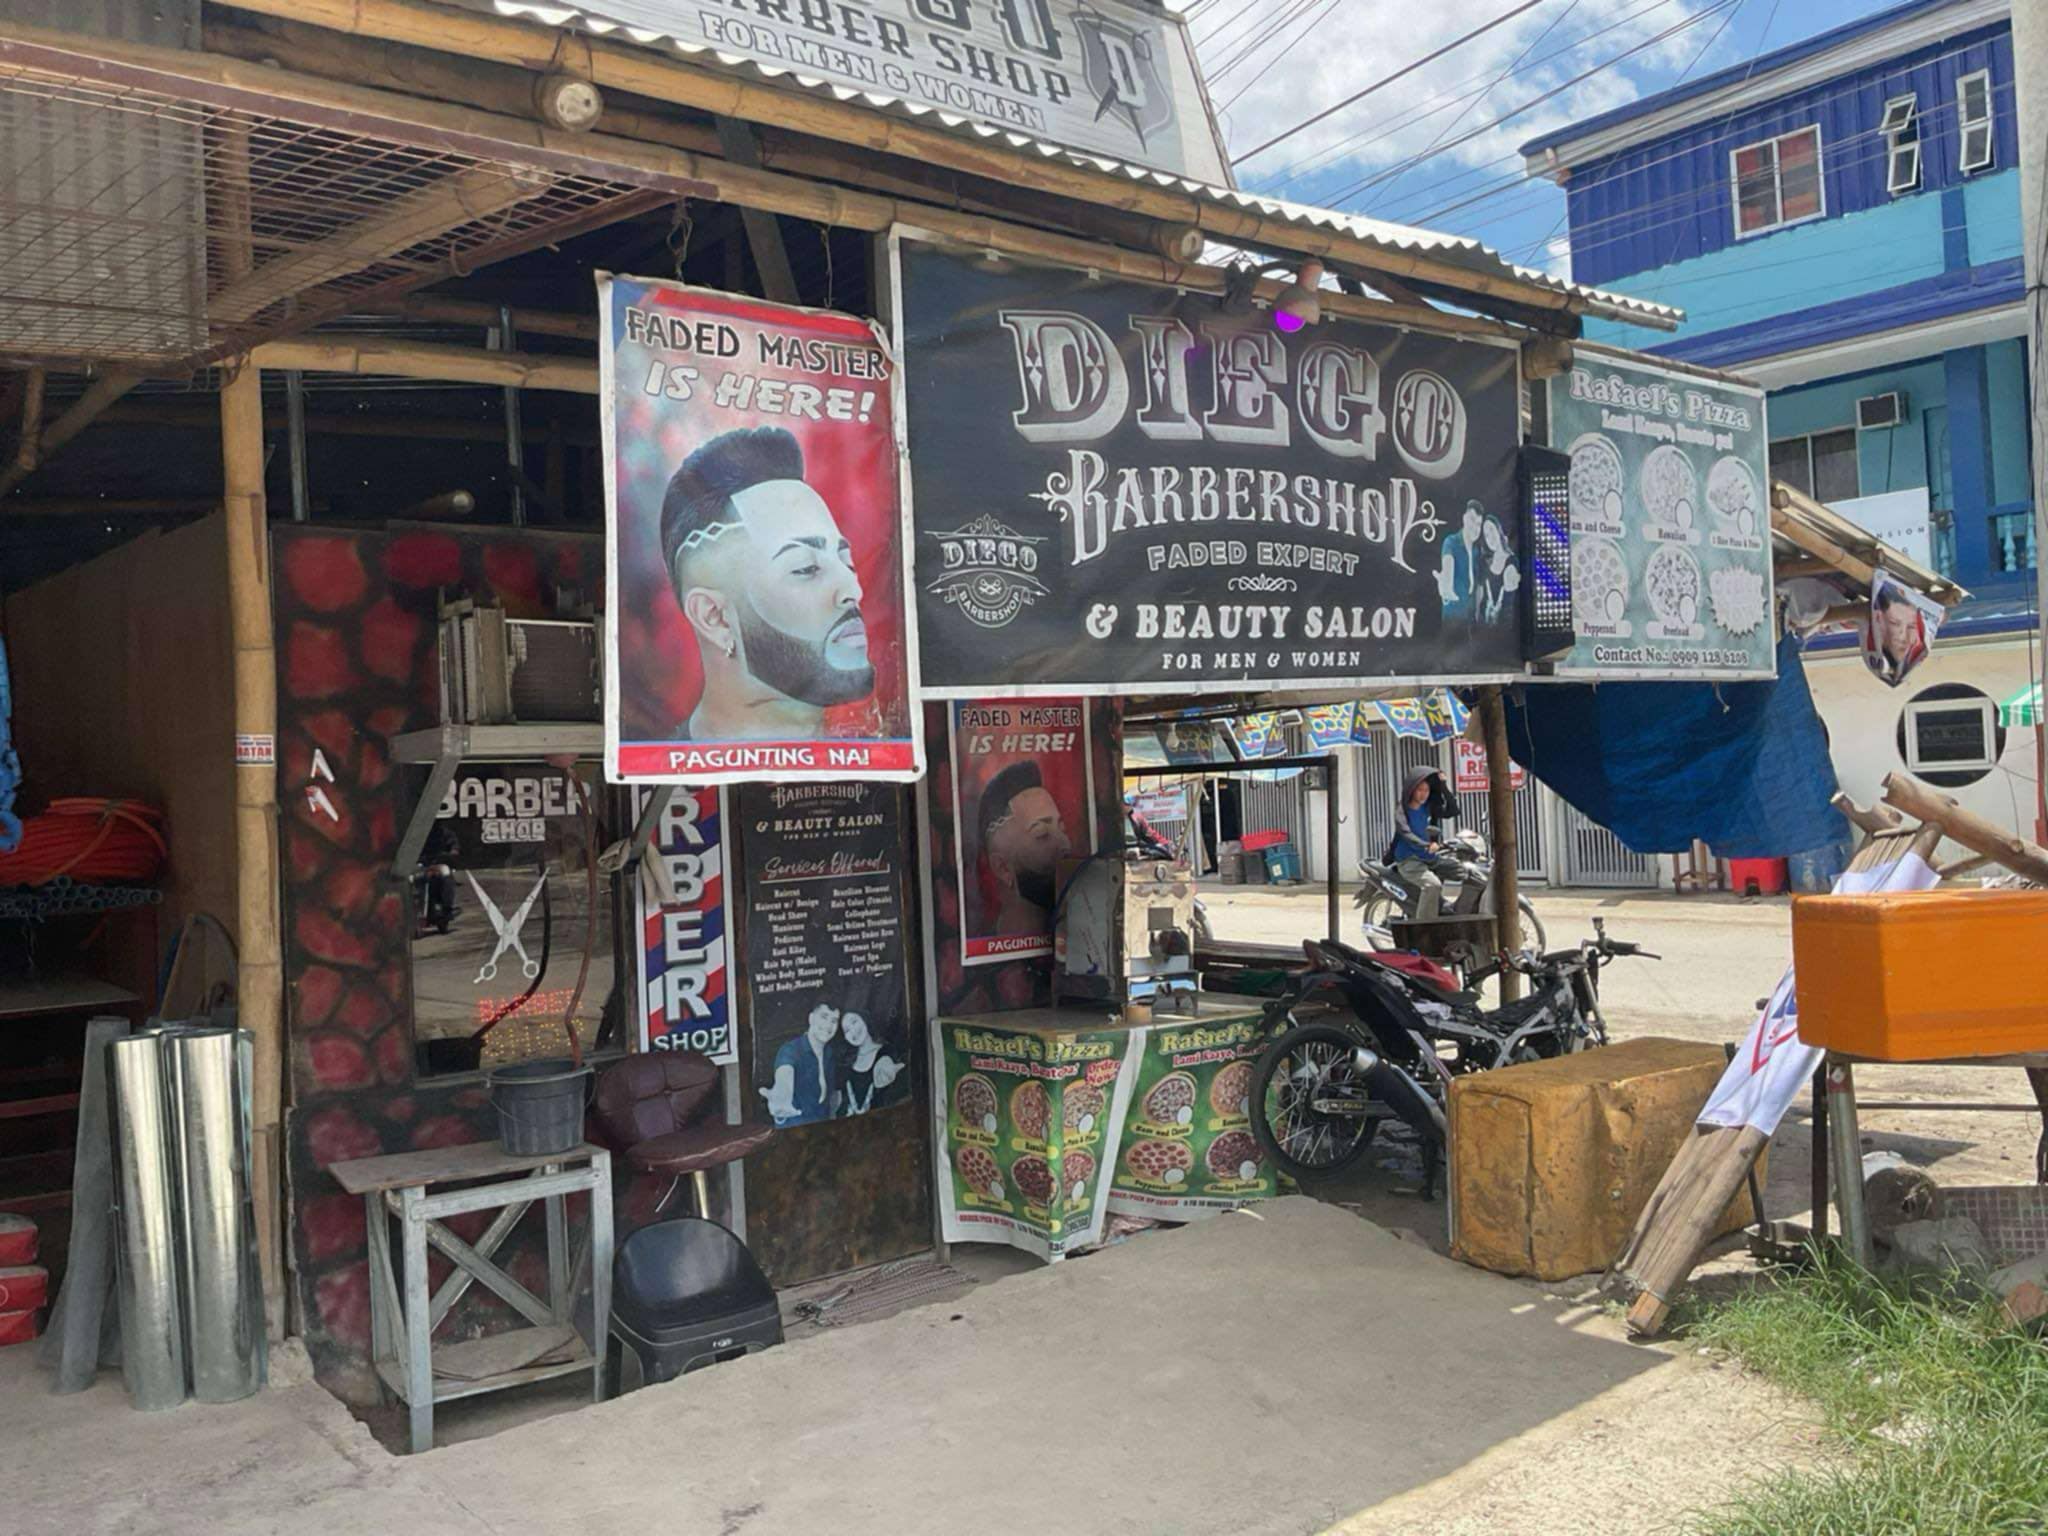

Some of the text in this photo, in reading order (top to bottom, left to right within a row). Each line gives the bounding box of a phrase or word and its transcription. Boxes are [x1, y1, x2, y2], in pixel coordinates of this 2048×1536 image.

[700, 12, 1046, 131] FOR MEN & WOMEN
[928, 33, 1071, 104] SHOP
[625, 307, 887, 380] FADED MASTER
[644, 360, 875, 423] IS HERE!
[1000, 310, 1467, 478] DIEGO
[1570, 368, 1680, 416] Rafael's
[1685, 390, 1751, 431] Pizza
[941, 539, 1037, 572] DIEGO
[1147, 541, 1360, 576] FADED EXPERT
[959, 590, 1020, 621] BARBERSHOP
[1085, 604, 1416, 639] & BEAUTY SALON
[1162, 652, 1361, 670] FOR MEN & WOMEN
[1594, 646, 1642, 662] Contact
[1673, 650, 1699, 666] 0909
[960, 707, 1080, 727] FADED MASTER
[670, 746, 870, 770] PAGUNTING NA!
[969, 732, 1076, 754] IS HERE!
[483, 818, 546, 843] SHOP
[756, 813, 883, 833] & BEAUTY SALON
[765, 849, 884, 879] Services Offered
[659, 786, 713, 1023] RBER
[653, 1026, 728, 1052] SHOP
[955, 1029, 1113, 1062] Rafael's Pizza
[1159, 1022, 1253, 1055] Rafael's
